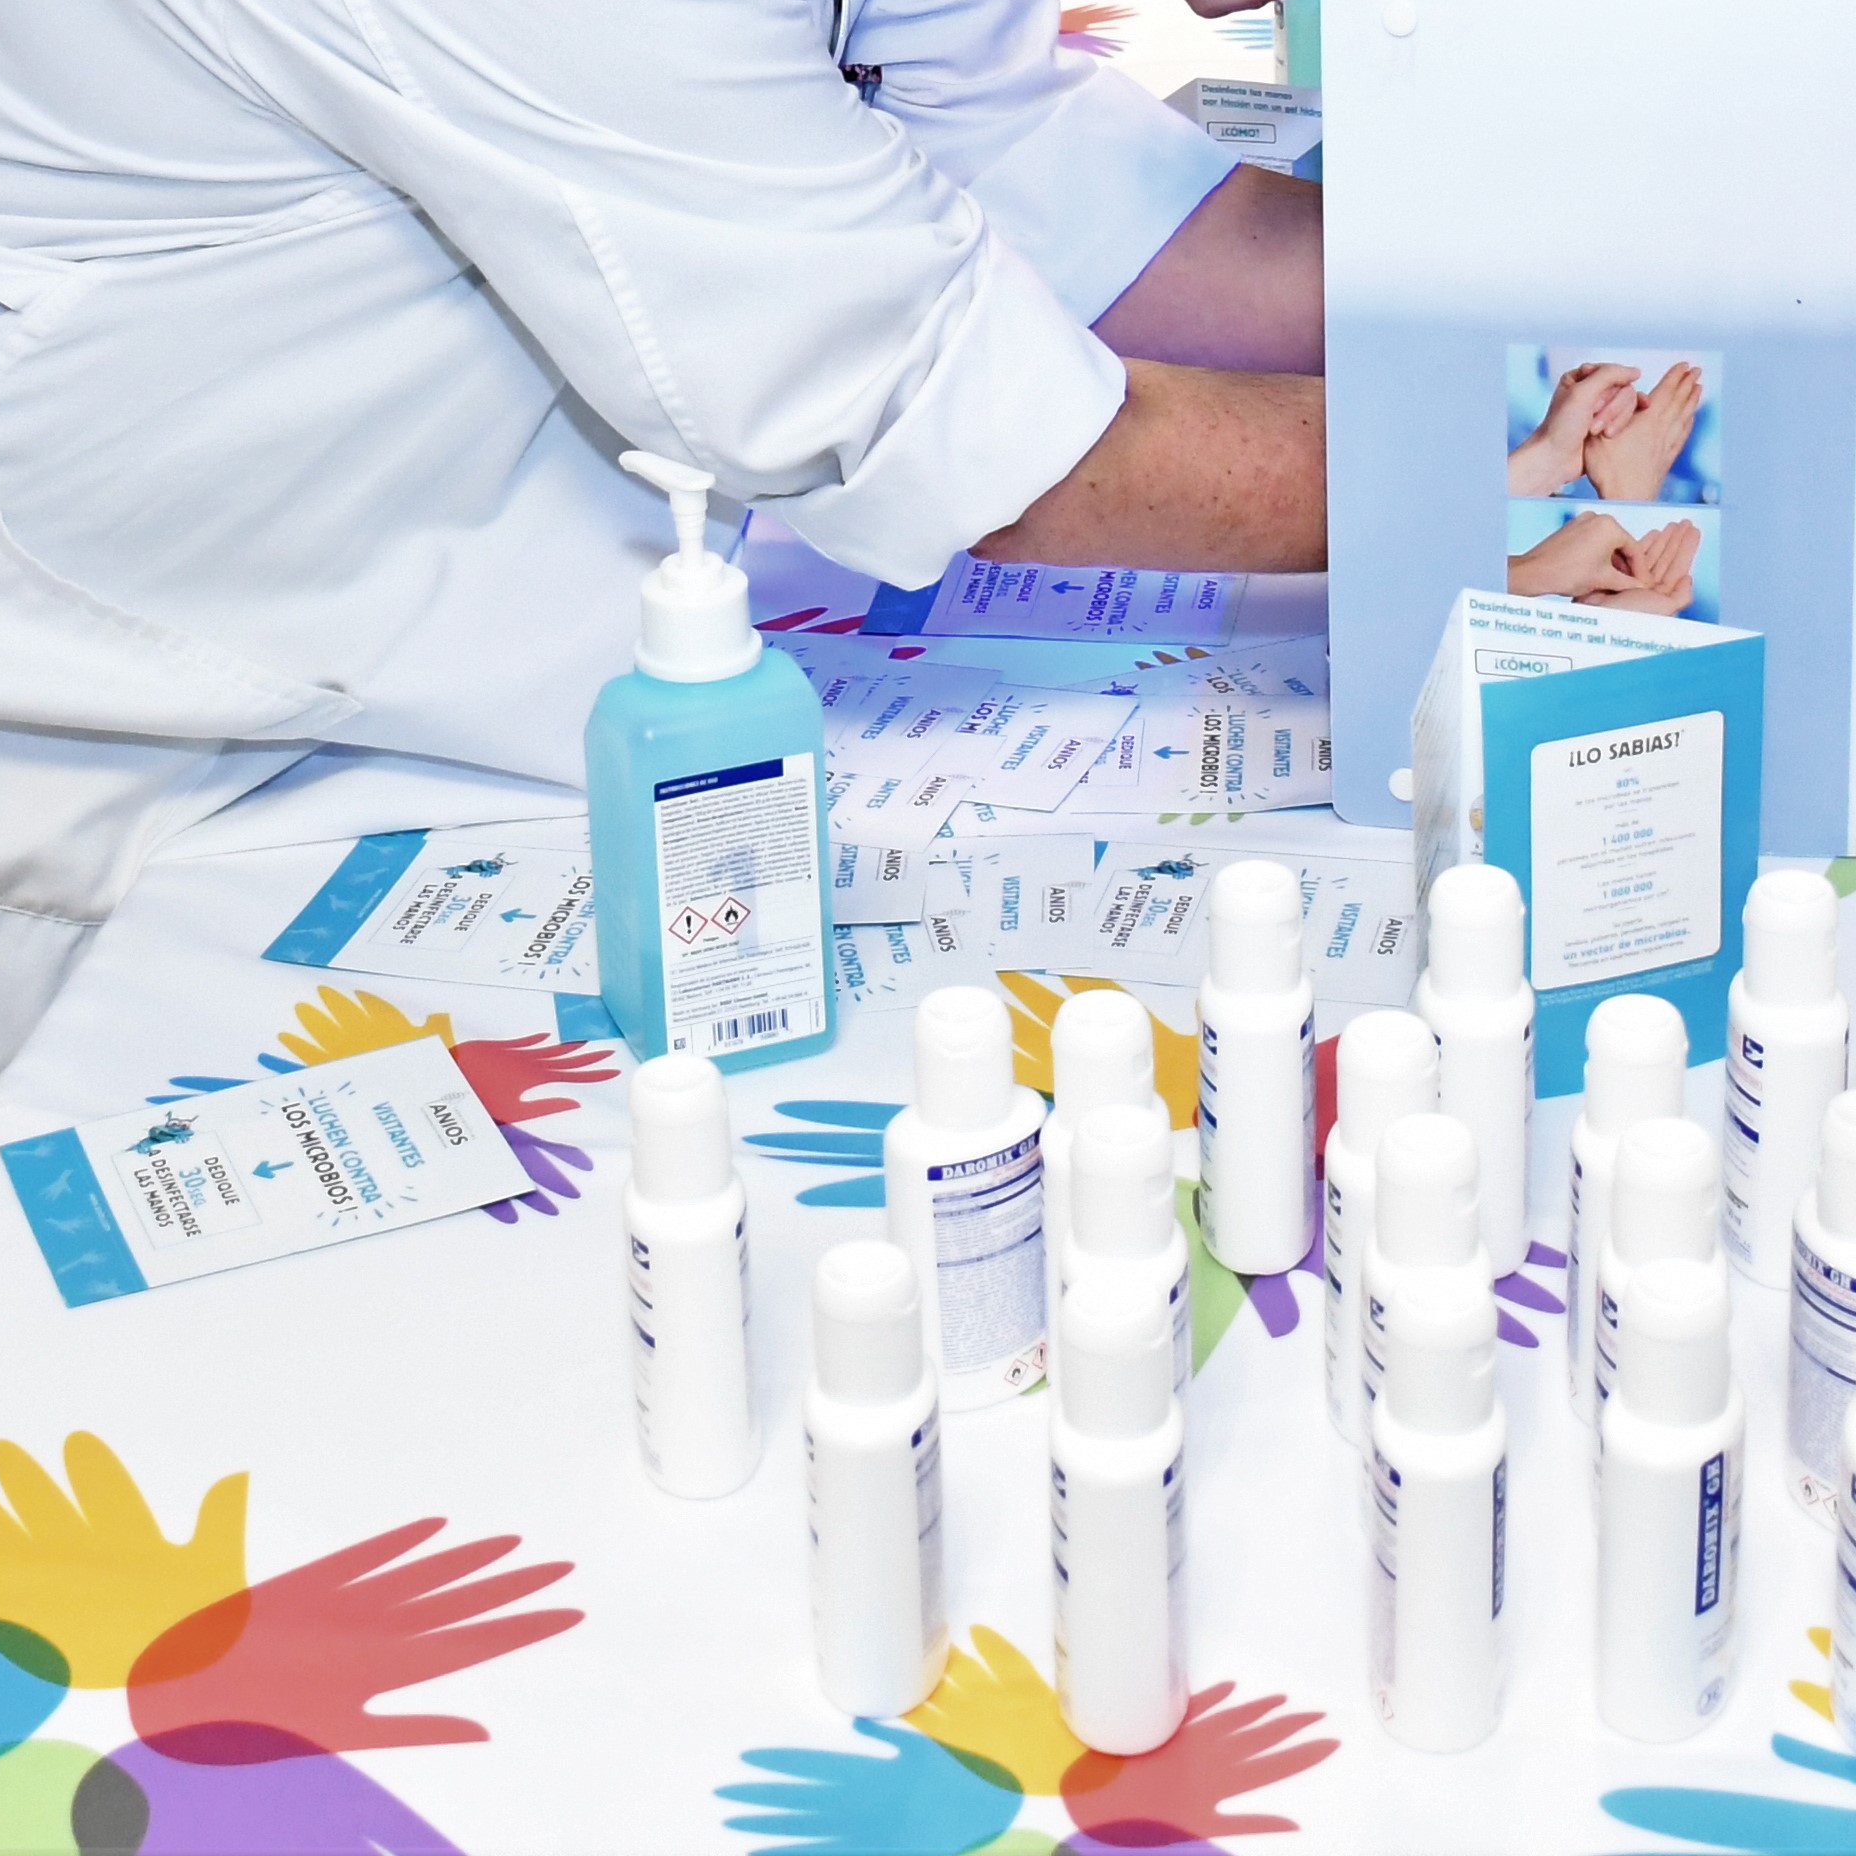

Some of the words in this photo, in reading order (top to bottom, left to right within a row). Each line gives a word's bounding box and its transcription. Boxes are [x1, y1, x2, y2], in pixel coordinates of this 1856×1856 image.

[1015, 568, 1040, 604] DEDIQUE
[1086, 570, 1117, 623] MICROBIOS
[1154, 572, 1181, 615] ISITANTES
[1197, 578, 1219, 611] ANIOS
[1107, 590, 1133, 627] CONTRA
[1468, 598, 1532, 618] Desinfecta
[1535, 608, 1553, 621] tus
[1558, 613, 1599, 627] manos
[1469, 617, 1491, 630] por
[1494, 619, 1537, 636] fricción
[1540, 628, 1563, 639] con
[1567, 631, 1583, 642] un
[1586, 632, 1607, 646] gel
[822, 677, 848, 708] ANIOS
[860, 695, 914, 741] VISITANTES
[906, 709, 942, 740] ANIOS
[1203, 713, 1222, 733] LOS
[1226, 711, 1246, 752] LUCHEN
[1000, 724, 1051, 772] VISITANTES
[1047, 739, 1082, 771] ANIOS
[1118, 735, 1136, 771] DEDIQUE
[1199, 733, 1221, 789] MICROBIOS
[1273, 727, 1292, 778] VISITANTES
[913, 776, 948, 808] ANIOS
[1224, 752, 1245, 793] CONTRA
[567, 874, 594, 897] LOS
[882, 848, 904, 882] ANIOS
[414, 883, 438, 901] LAS
[453, 892, 493, 933] DEDIQUE
[999, 875, 1021, 932] VISITANTES
[1048, 886, 1066, 924] ANIOS
[1117, 885, 1134, 906] LAS
[391, 899, 425, 931] MANOS
[399, 881, 459, 945] DESINFECTARSE
[522, 896, 580, 960] MICROBIOS
[1098, 903, 1125, 935] MANOS
[1110, 883, 1153, 949] DESINFECTARSE
[1162, 895, 1193, 936] DEDIQUE
[1325, 901, 1363, 959] VISITANTES
[547, 920, 585, 965] CONTRA
[930, 916, 957, 954] ANIOS
[1376, 917, 1404, 956] ANIOS
[836, 941, 867, 989] CONTRA
[371, 1101, 425, 1170] VISITANTES
[429, 1103, 469, 1147] ANIOS
[280, 1101, 312, 1131] LOS
[296, 1127, 354, 1206] MICROBIOS
[308, 1095, 353, 1150] LUCHEN
[338, 1147, 383, 1205] CONTRA
[133, 1167, 154, 1192] LAS
[150, 1157, 203, 1239] DESINFECTARSE
[203, 1156, 241, 1207] DEDIQUE
[142, 1189, 175, 1228] MANOS
